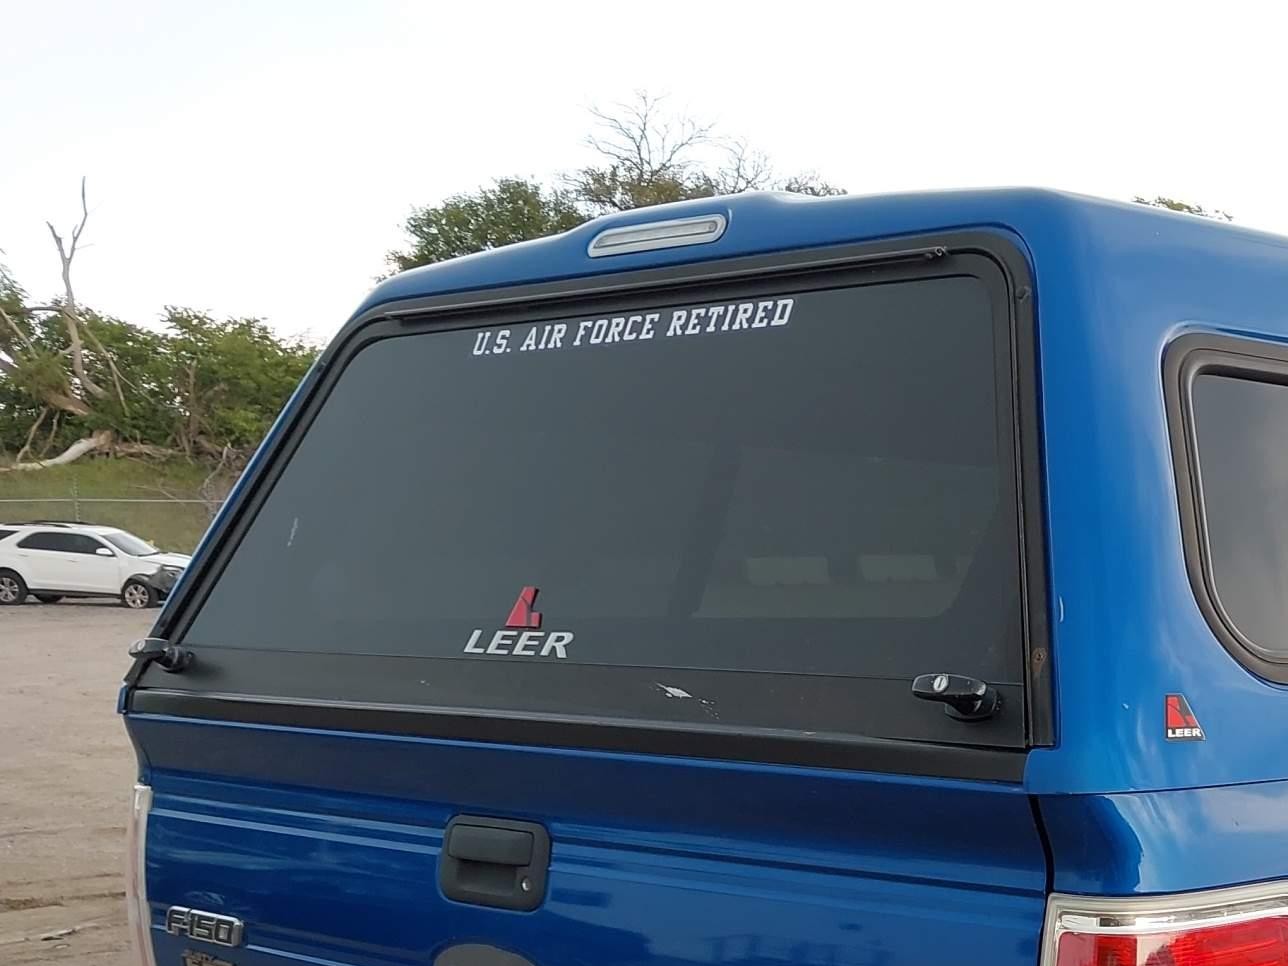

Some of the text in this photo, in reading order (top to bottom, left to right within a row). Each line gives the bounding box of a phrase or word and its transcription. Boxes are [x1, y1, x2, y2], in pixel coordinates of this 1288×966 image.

[473, 299, 794, 356] U.S. AIR FORCE RETIRED
[464, 629, 575, 659] LEER
[1167, 728, 1202, 738] LEER
